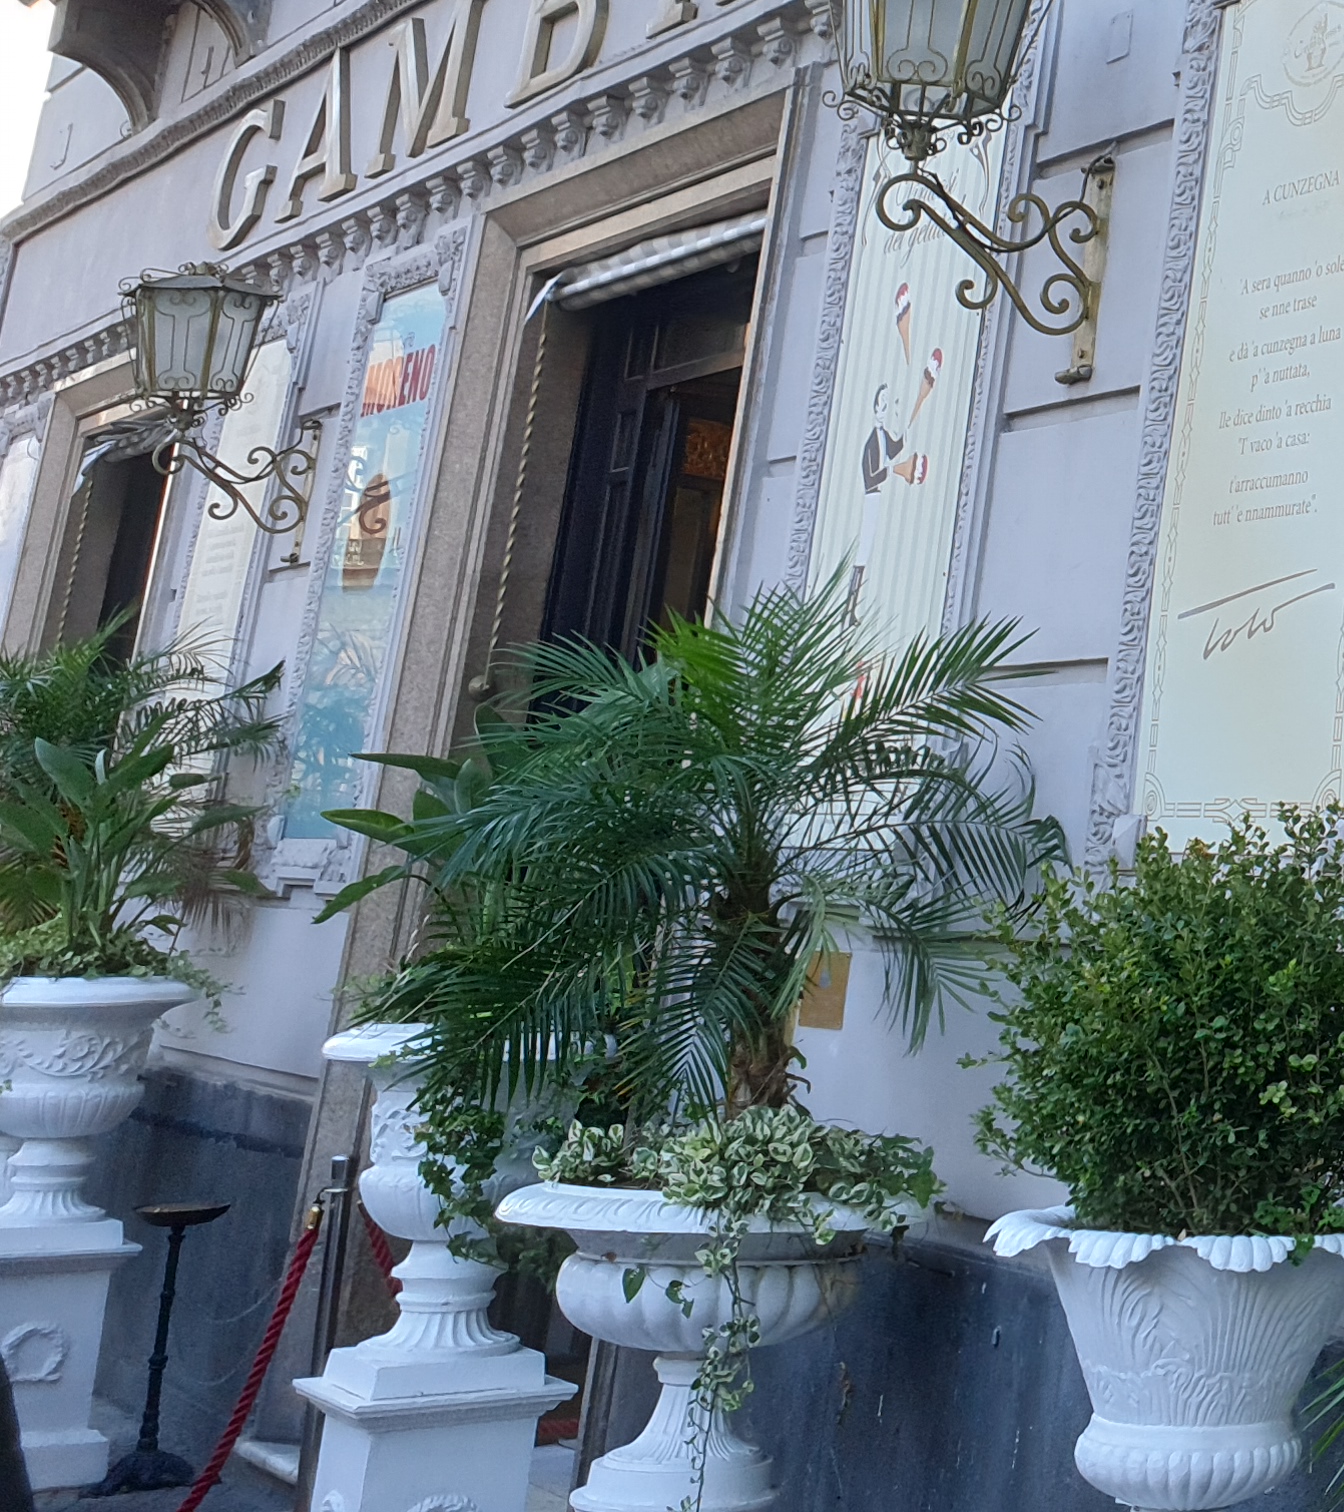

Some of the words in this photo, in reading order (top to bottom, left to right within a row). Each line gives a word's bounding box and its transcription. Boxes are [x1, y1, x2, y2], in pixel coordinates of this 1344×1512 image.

[1273, 170, 1340, 202] CUNZEGNA
[1251, 277, 1271, 293] sera
[1273, 268, 1312, 293] quanno
[1259, 306, 1270, 320] se
[1271, 301, 1291, 317] nne
[1293, 295, 1317, 312] trase
[1261, 335, 1307, 356] cunzegna
[1318, 325, 1341, 344] luna
[1233, 408, 1254, 427] dice
[1255, 404, 1282, 423] dinto
[1294, 394, 1331, 416] recchia
[1250, 438, 1273, 453] vaco
